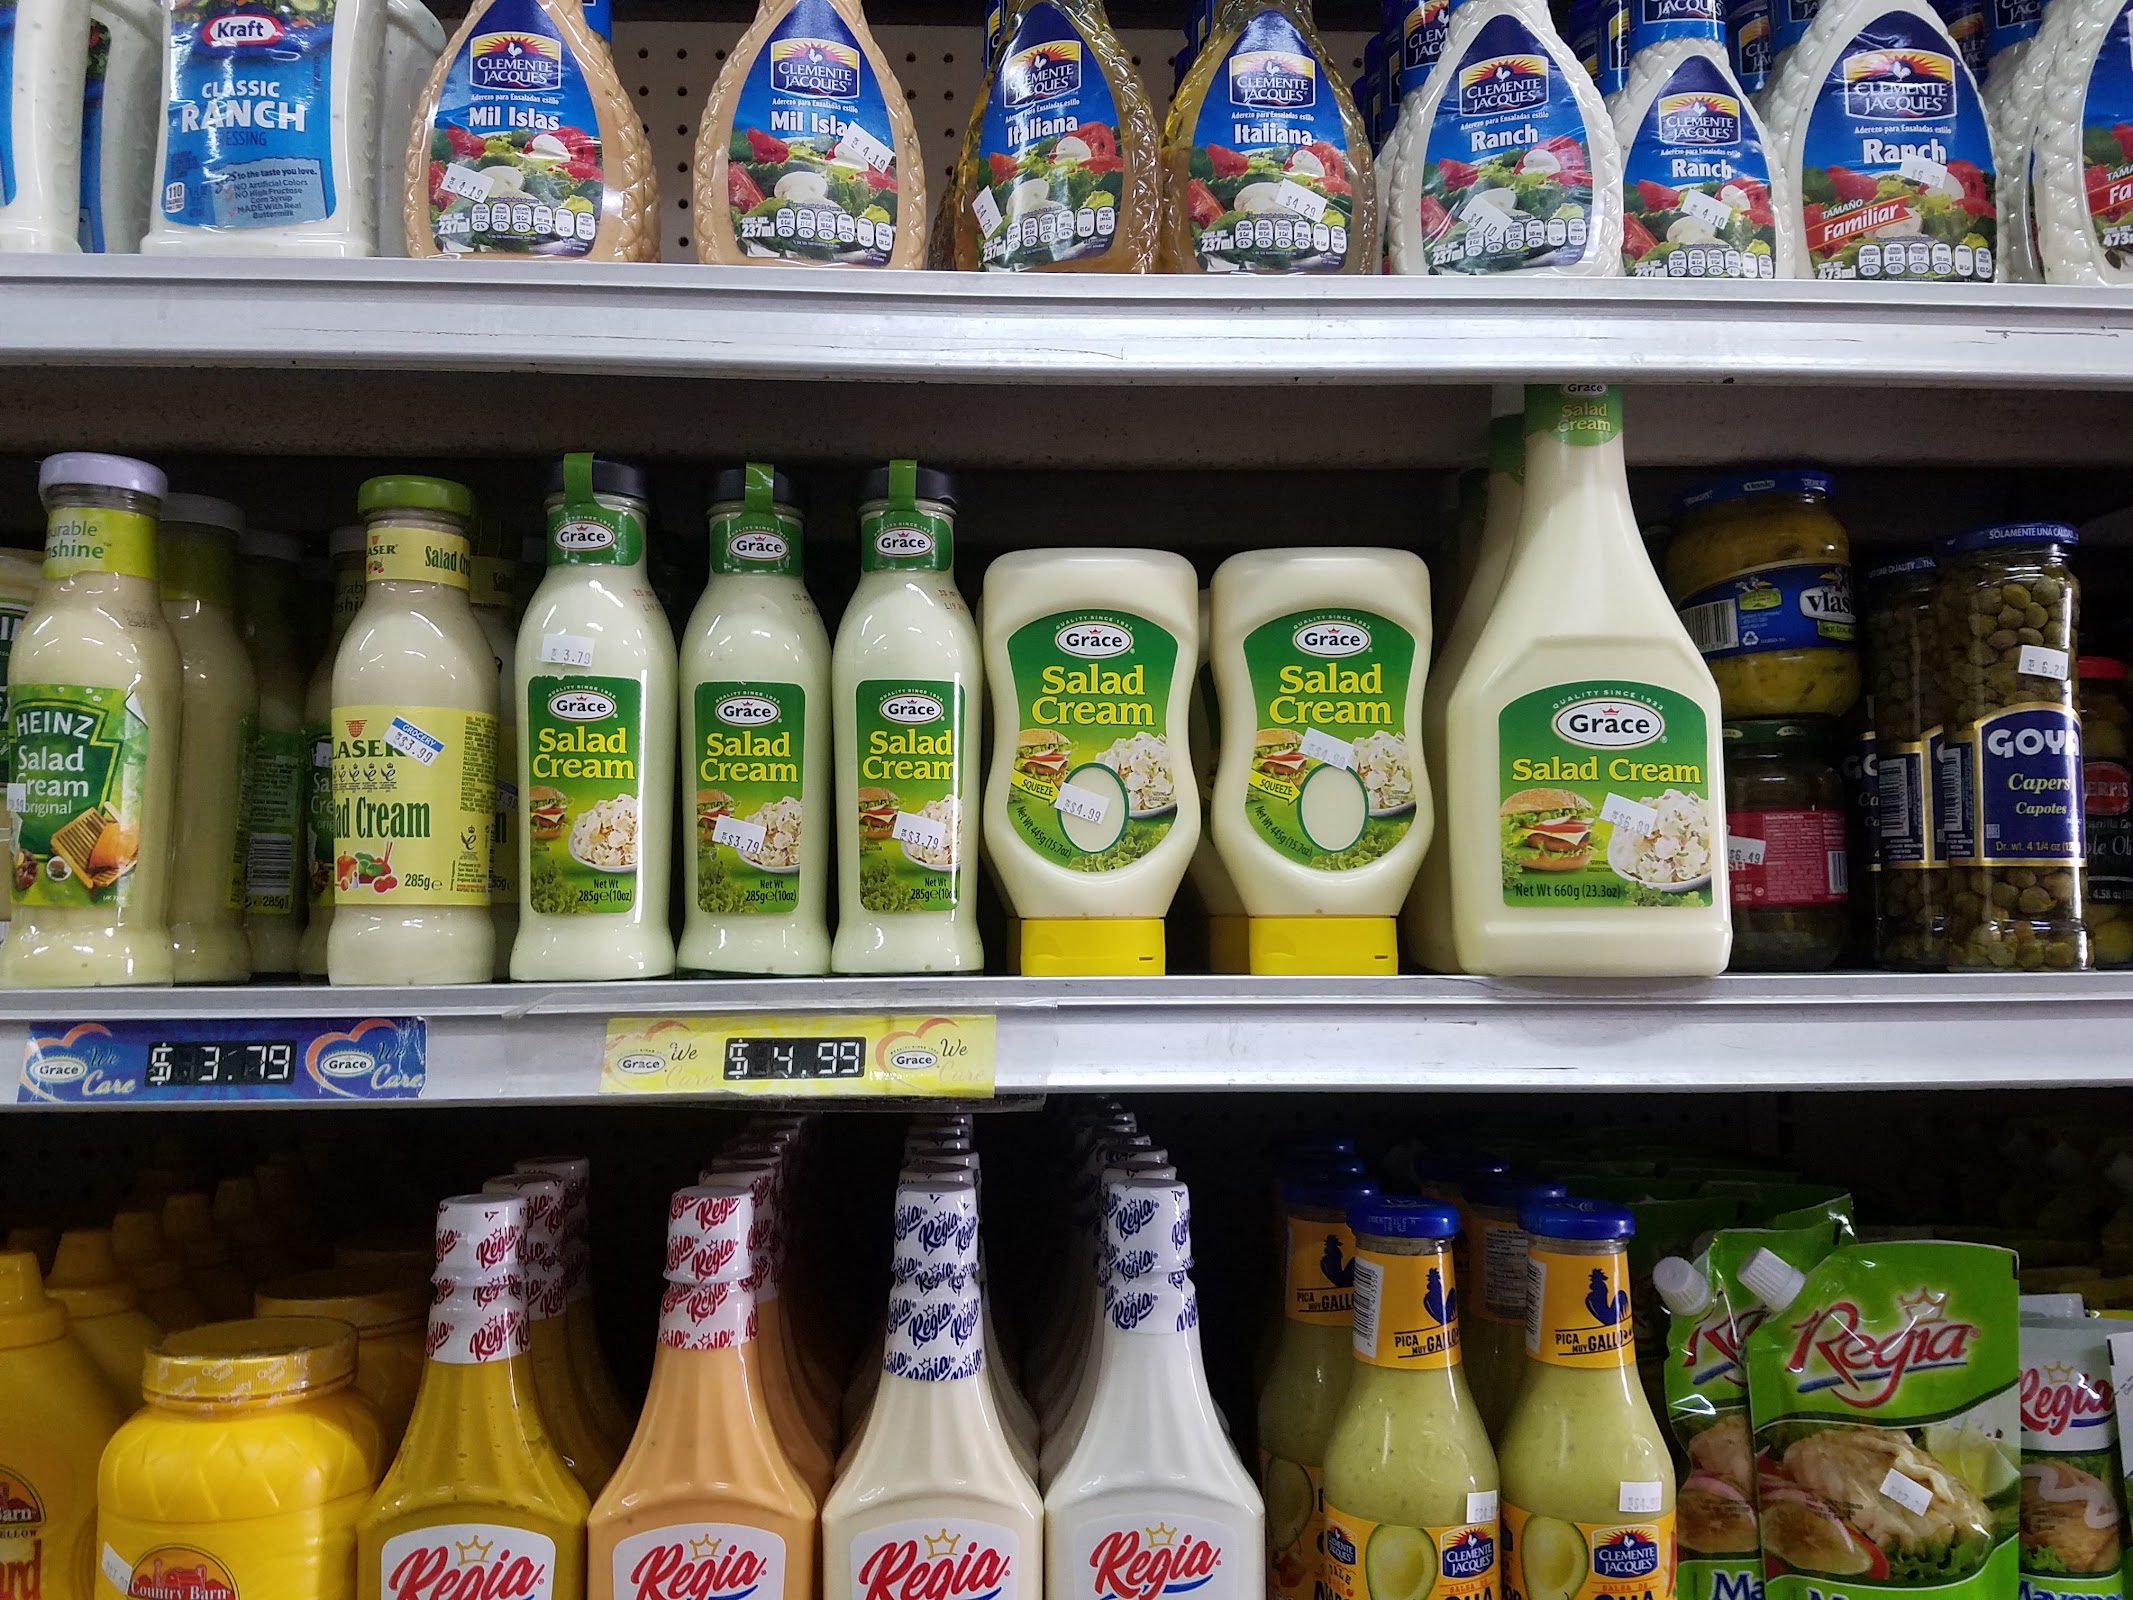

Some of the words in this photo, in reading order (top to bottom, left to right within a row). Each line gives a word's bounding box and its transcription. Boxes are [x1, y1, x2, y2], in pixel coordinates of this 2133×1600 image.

[217, 21, 264, 38] Kraft
[477, 57, 553, 73] CLEMENTE
[779, 62, 852, 81] CLEMENTE
[482, 70, 548, 86] JACQUES
[784, 75, 848, 93] JACQUES
[1236, 76, 1308, 90] CLEMENTE
[201, 80, 280, 98] CLASSIC
[1242, 88, 1304, 104] JACQUES
[1466, 78, 1541, 99] CLEMENTE
[1855, 81, 1949, 98] CLEMENTE
[1473, 90, 1537, 113] JACQUES
[1864, 96, 1944, 115] JACQUES
[181, 100, 305, 133] RANCH
[469, 106, 500, 127] Mil
[508, 106, 560, 131] Islas
[1666, 115, 1734, 129] CLEMENTE
[1007, 115, 1079, 148] Italiana
[1234, 123, 1313, 147] Italiana
[1471, 124, 1538, 152] Ranch
[1672, 127, 1730, 142] JACQUES
[1854, 126, 1883, 134] Aderezo
[1884, 125, 1900, 134] para
[1901, 124, 1934, 134] Ensaladas
[1863, 138, 1947, 165] Ranch
[1671, 158, 1733, 180] Ranch
[168, 185, 182, 198] 110
[1702, 208, 1724, 227] 4.10
[1824, 202, 1899, 242] Familiar
[1561, 402, 1607, 418] Salad
[1557, 418, 1611, 432] Cream
[560, 529, 606, 543] Grace
[881, 537, 926, 549] Grace
[1988, 527, 2036, 541] SOLAMENTE
[2037, 526, 2052, 537] UNA
[736, 540, 782, 554] Grace
[424, 545, 458, 573] Salad
[1066, 633, 1123, 648] Grace
[1304, 632, 1361, 647] Grace
[563, 647, 591, 666] 3.79
[1041, 663, 1146, 696] Salad
[1279, 662, 1384, 695] Salad
[556, 700, 607, 714] Grace
[888, 703, 935, 716] Grace
[1552, 689, 1599, 710] QUALITY
[1603, 689, 1636, 699] SINCE
[1640, 695, 1664, 711] 1922
[723, 705, 771, 718] Grace
[1031, 696, 1155, 727] Cream
[1269, 695, 1393, 726] Cream
[16, 711, 95, 740] HEINZ
[1569, 714, 1650, 734] Grace
[402, 723, 437, 748] GROCERY
[538, 726, 628, 754] Salad
[706, 730, 791, 758] Salad
[869, 728, 954, 755] Salad
[1987, 728, 2080, 759] GOYA
[18, 745, 84, 772] Salad
[398, 736, 434, 763] $3.99
[532, 754, 635, 780] Cream
[700, 758, 798, 783] Cream
[862, 756, 957, 780] Cream
[1511, 755, 1599, 781] Salad
[1608, 758, 1702, 783] Cream
[1021, 779, 1054, 797] SQUEEZE
[1259, 778, 1293, 796] SQUEEZE
[2008, 773, 2071, 795] Capers
[355, 796, 431, 839] Cream
[1069, 800, 1102, 822] $4.99
[2015, 802, 2068, 817] Capotes
[908, 830, 939, 849] $3.79
[1016, 806, 1028, 820] Net
[1022, 816, 1033, 828] Wt
[1030, 824, 1047, 845] 445g
[1045, 836, 1072, 859] (15.7oz)
[1254, 805, 1265, 819] Net
[1260, 815, 1272, 828] Wt
[1269, 825, 1286, 846] 445g
[1284, 836, 1313, 857] (15.7oz)
[727, 834, 760, 853] $3.79
[2027, 842, 2033, 850] 4
[2035, 841, 2049, 850] 1/4
[404, 873, 431, 891] 285g
[593, 879, 607, 888] Net
[608, 879, 619, 888] Wt
[760, 879, 772, 889] Net
[773, 880, 784, 889] Wt
[925, 877, 936, 887] Net
[937, 878, 947, 887] Wt
[1515, 883, 1533, 897] Net
[1536, 883, 1551, 897] Wt
[1554, 883, 1580, 900] 660g
[1582, 884, 1621, 899] (23.3oz)
[91, 1046, 119, 1067] We
[669, 1041, 698, 1062] We
[939, 1037, 969, 1058] We
[150, 1043, 172, 1086] $
[199, 1044, 292, 1081] 3.79
[328, 1058, 369, 1070] Grace
[621, 1057, 661, 1070] Grace
[728, 1038, 749, 1080] $
[772, 1041, 861, 1079] 4.99
[896, 1054, 933, 1066] Grace
[39, 1064, 80, 1076] Grace
[371, 1069, 423, 1090] Care
[82, 1076, 136, 1096] Care
[1395, 1335, 1419, 1348] PICA
[1412, 1345, 1426, 1355] MUY
[1555, 1333, 1580, 1345] PICA
[1572, 1343, 1588, 1353] MUY
[1786, 1300, 1973, 1408] Regia
[2020, 1367, 2115, 1436] Regia
[1446, 1542, 1492, 1564] CLEMENTE
[1599, 1547, 1655, 1561] CLEMENTE
[389, 1546, 545, 1600] Regia
[631, 1544, 768, 1600] Regia
[858, 1541, 1011, 1600] Regia
[1090, 1532, 1222, 1600] Regia
[1451, 1555, 1491, 1577] JACQUES
[1605, 1559, 1652, 1575] JACQUES
[131, 1580, 185, 1600] Country
[189, 1584, 228, 1600] Barn
